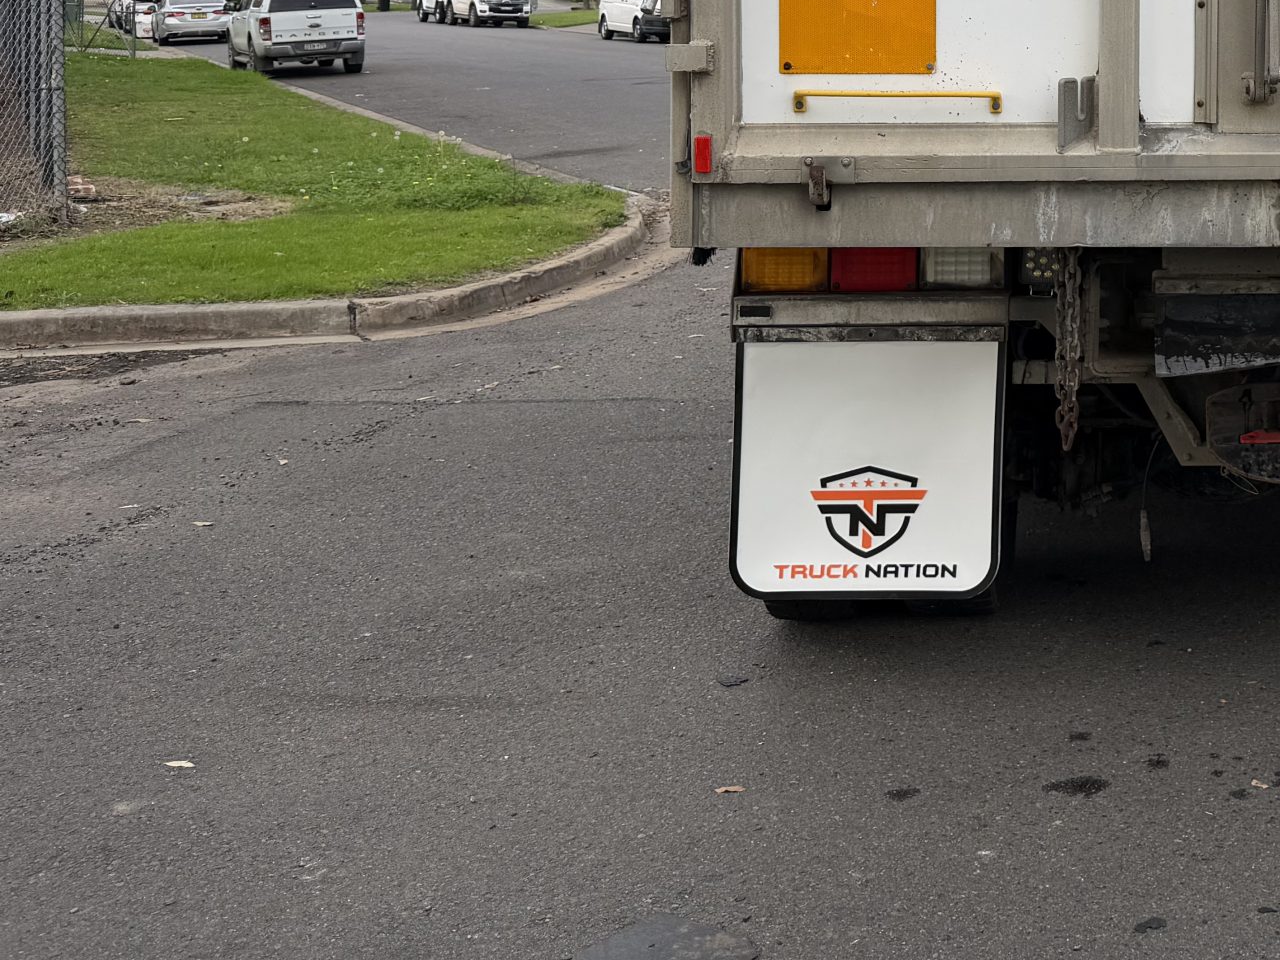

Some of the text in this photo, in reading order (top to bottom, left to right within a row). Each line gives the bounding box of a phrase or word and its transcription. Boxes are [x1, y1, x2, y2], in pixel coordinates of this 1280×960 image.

[275, 30, 354, 38] RANGER
[773, 563, 957, 579] TRUCK NATION
